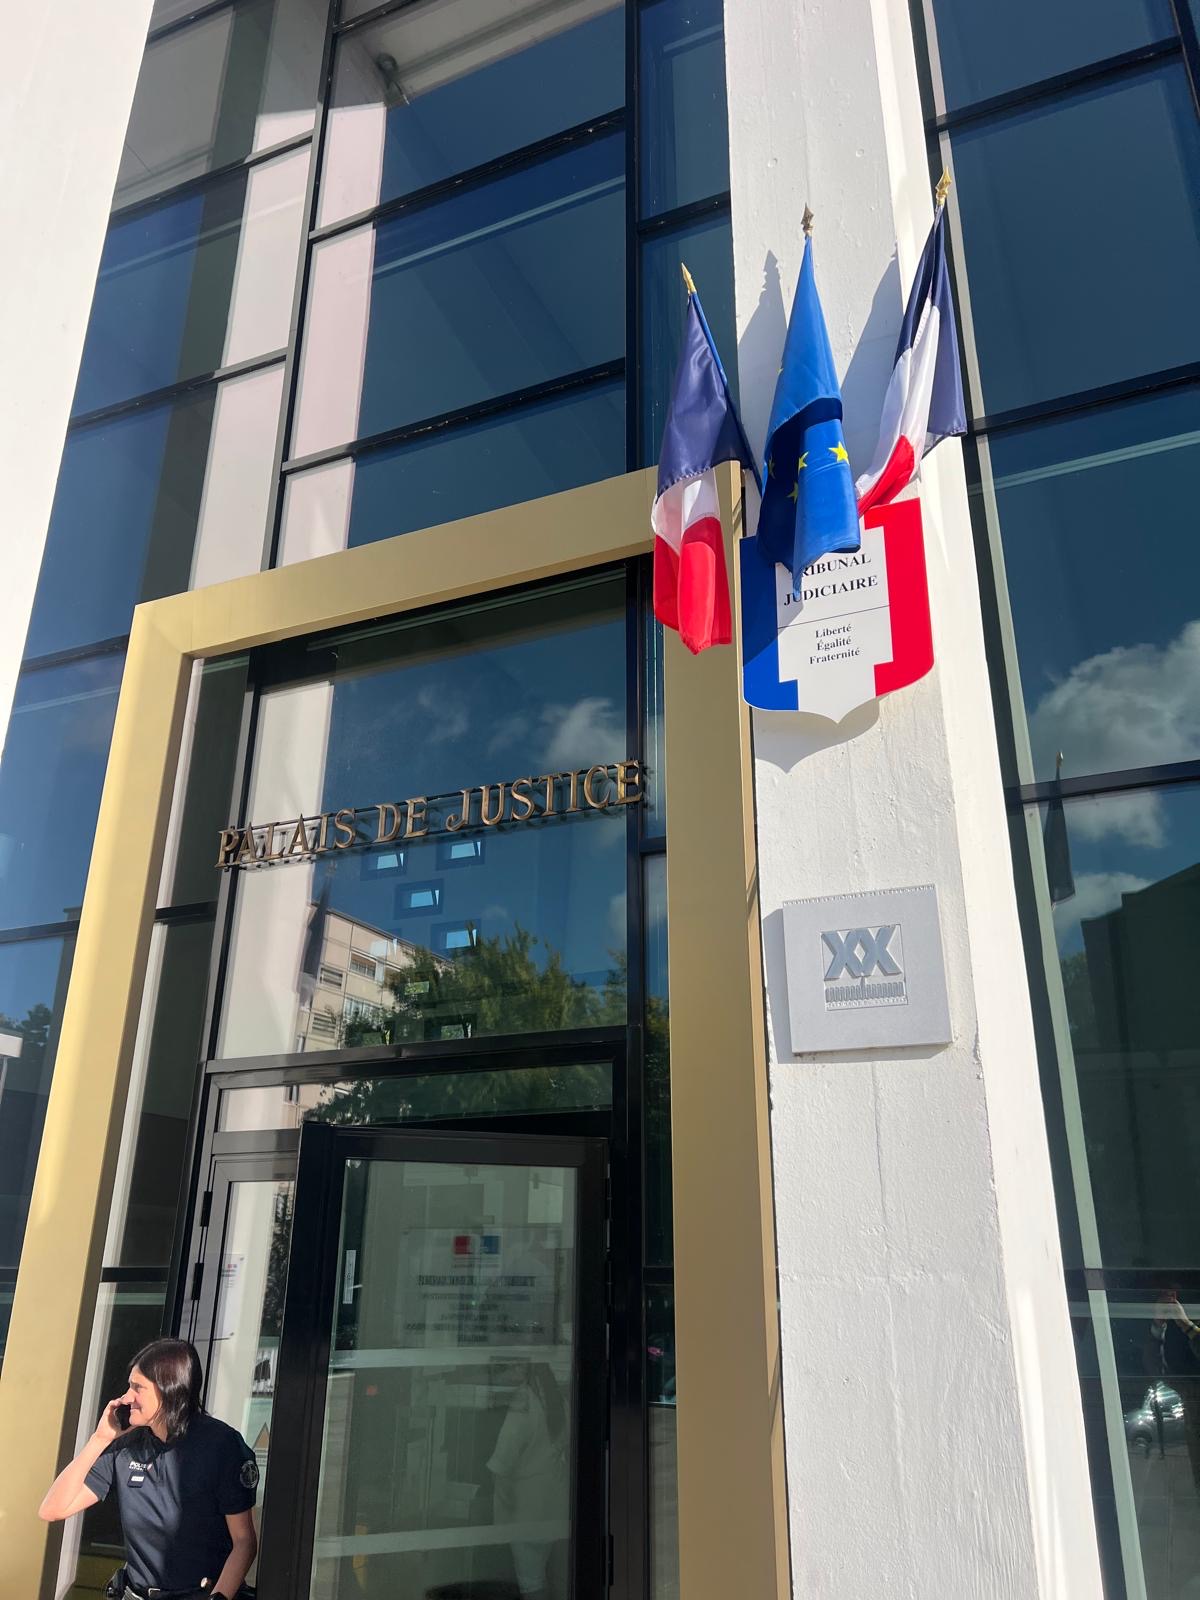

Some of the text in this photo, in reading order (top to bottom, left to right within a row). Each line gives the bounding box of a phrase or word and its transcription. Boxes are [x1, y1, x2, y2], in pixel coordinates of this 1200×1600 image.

[802, 553, 871, 577] RIBUNAL
[815, 623, 852, 638] Liberté
[817, 635, 852, 651] Égalité
[809, 647, 860, 664] Fraternité
[215, 760, 643, 868] PALAIS DE JUSTICE
